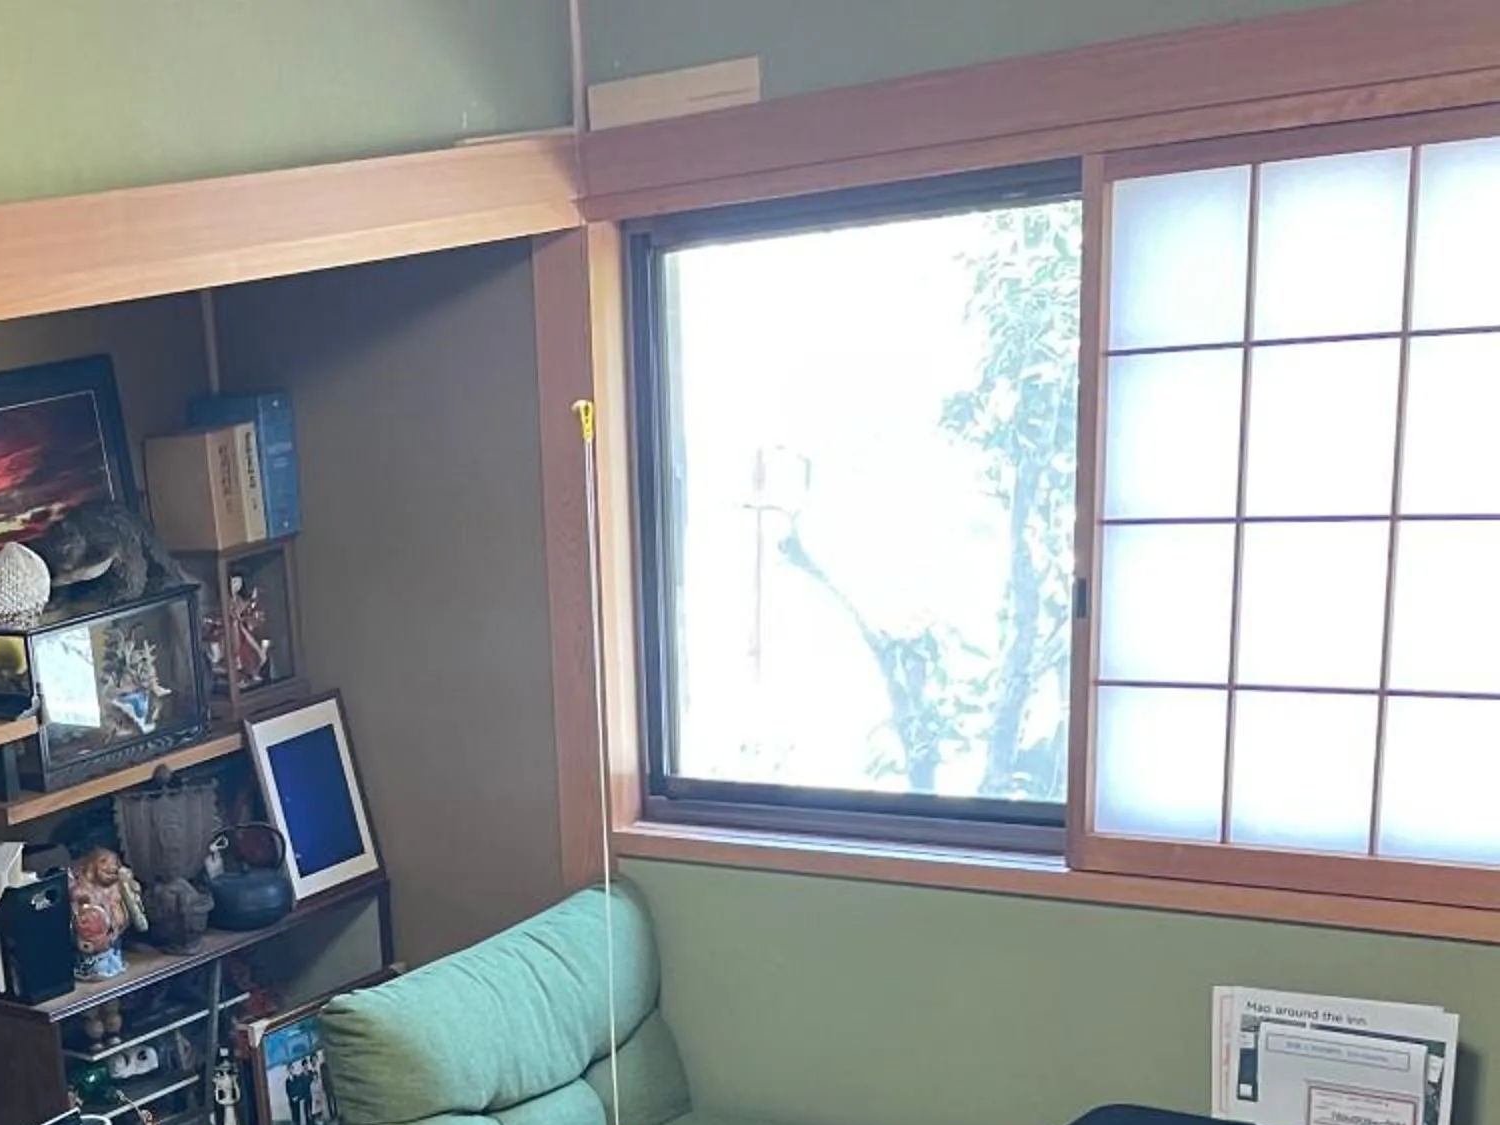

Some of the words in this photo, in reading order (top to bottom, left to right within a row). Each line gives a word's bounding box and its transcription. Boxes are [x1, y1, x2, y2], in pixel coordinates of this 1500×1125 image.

[1245, 1000, 1271, 1015] Map
[1275, 1006, 1319, 1021] around
[1322, 1010, 1343, 1024] the
